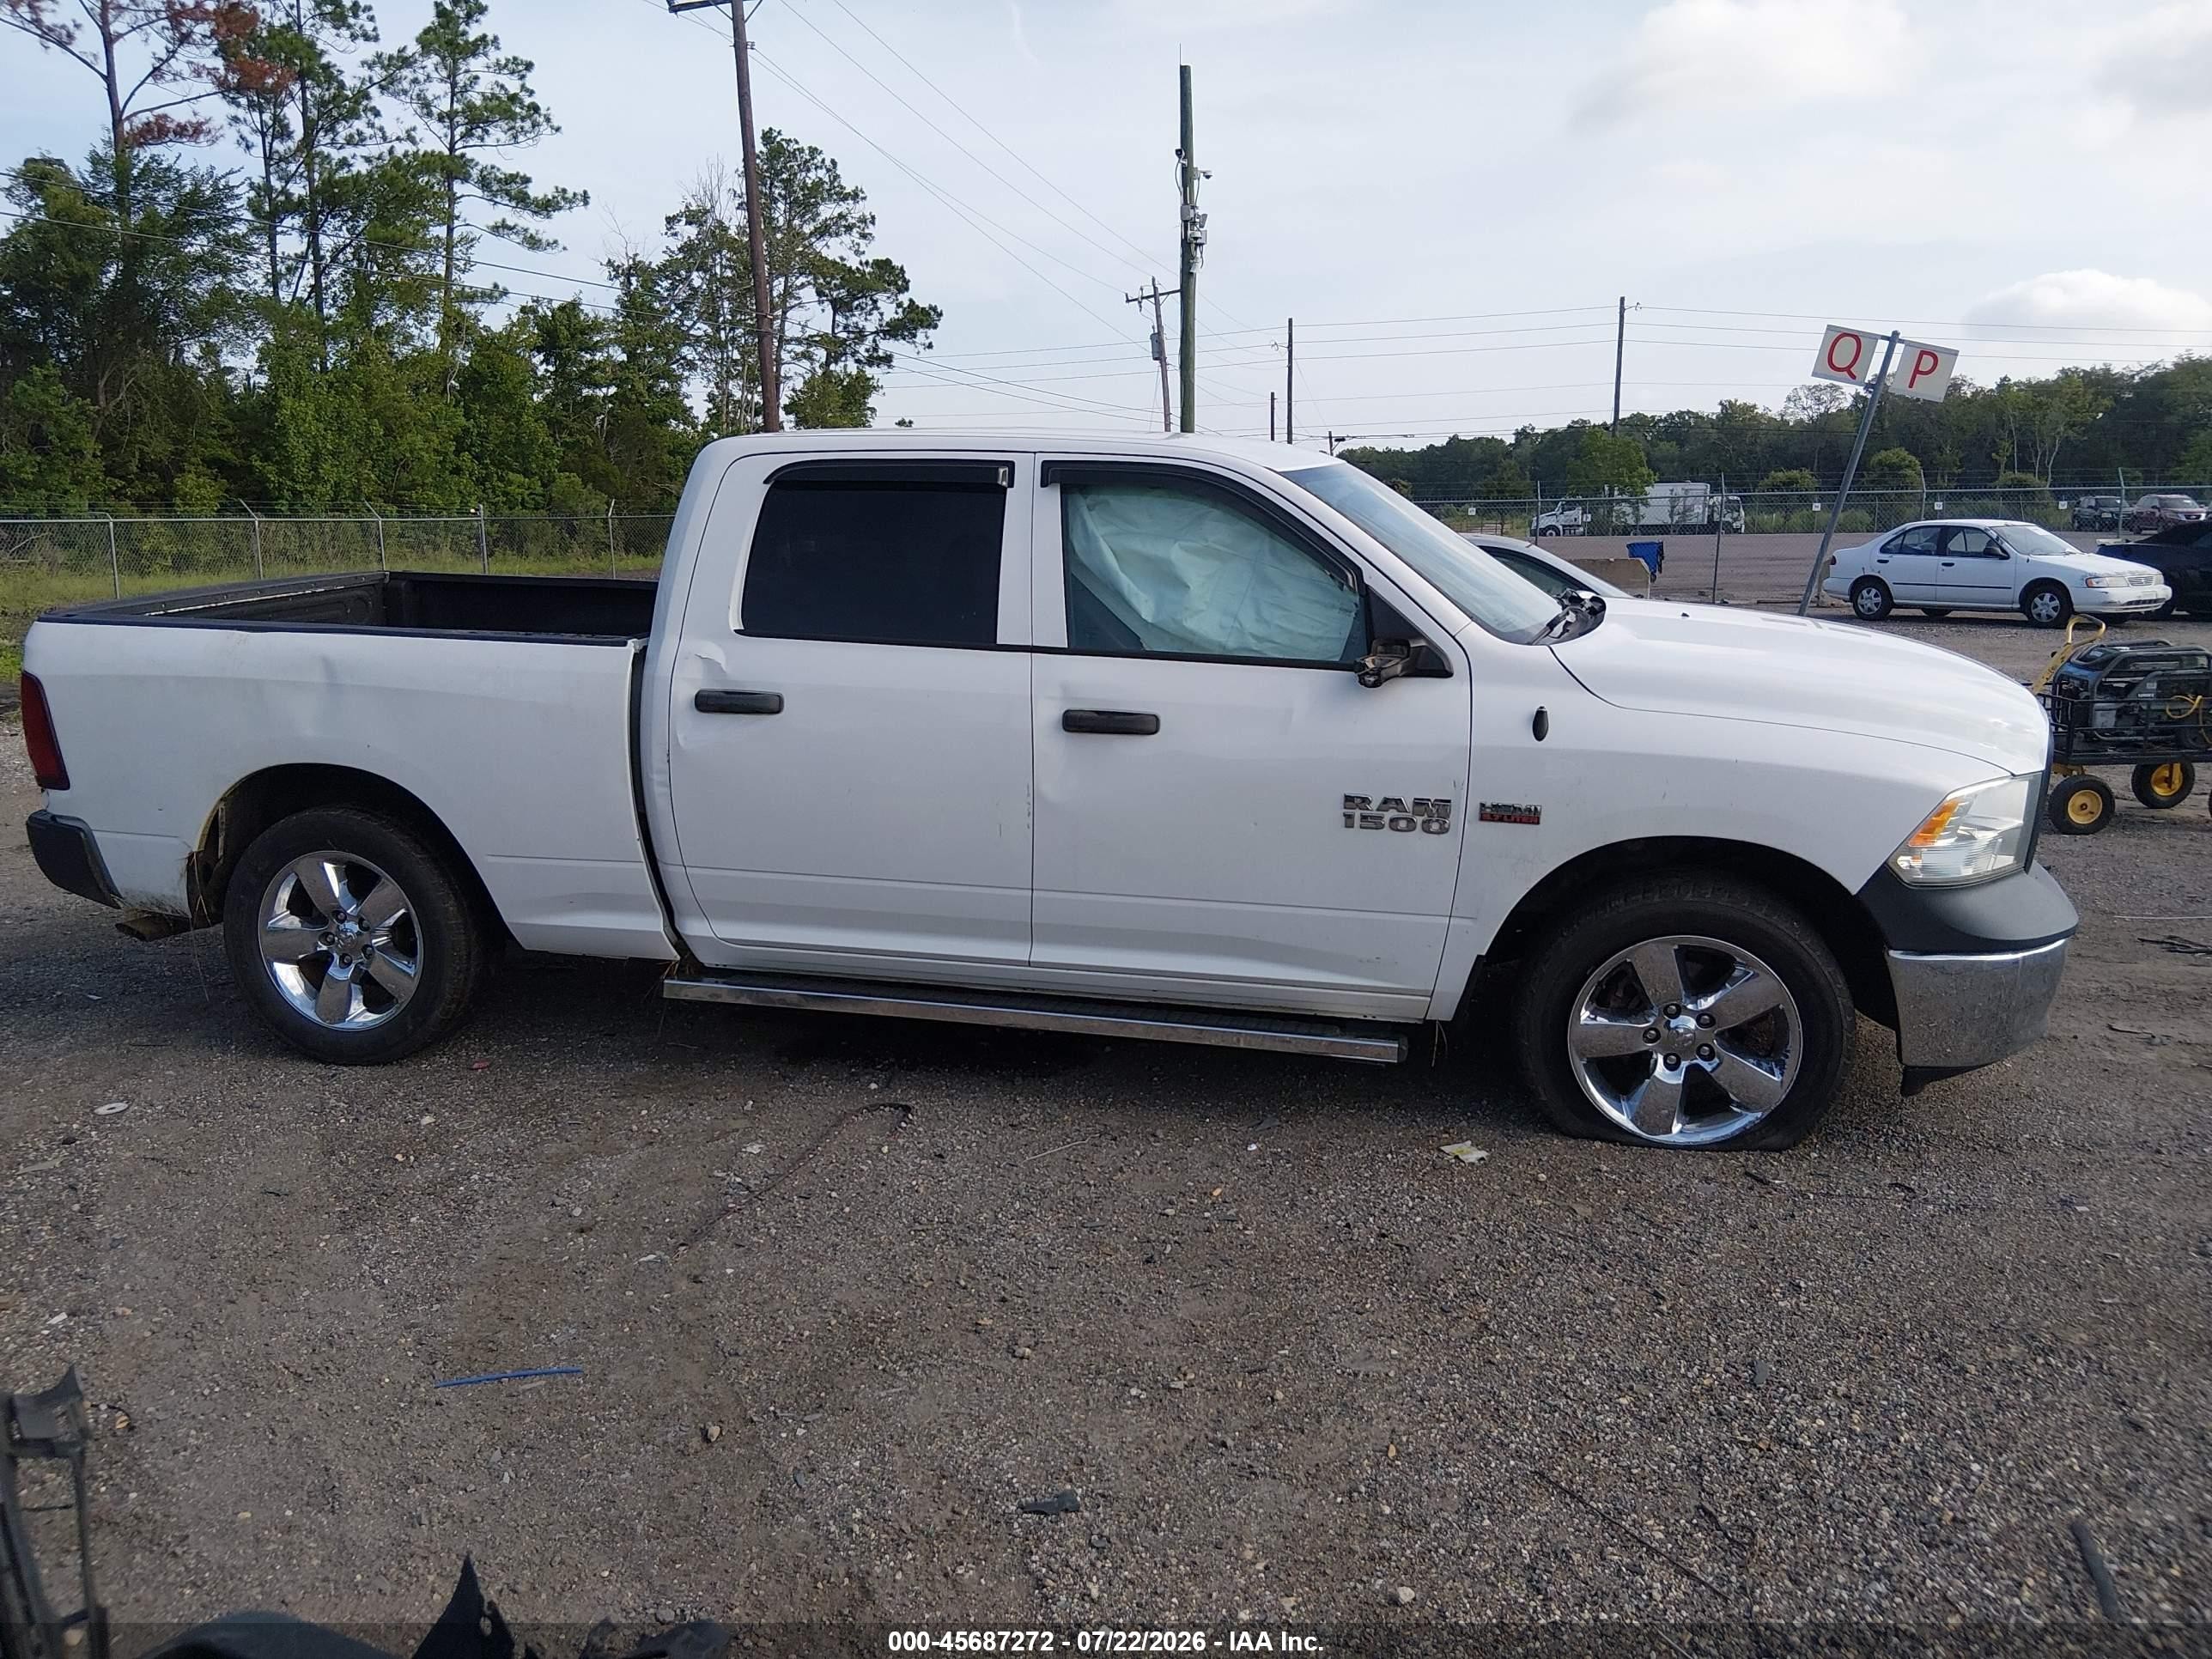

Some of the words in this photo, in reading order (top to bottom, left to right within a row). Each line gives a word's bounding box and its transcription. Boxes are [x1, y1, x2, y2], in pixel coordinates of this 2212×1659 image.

[1827, 332, 1862, 380] Q
[1908, 349, 1939, 389] P
[1343, 793, 1451, 818] RAM
[1480, 802, 1541, 816] HEMI
[1343, 811, 1450, 835] 1500
